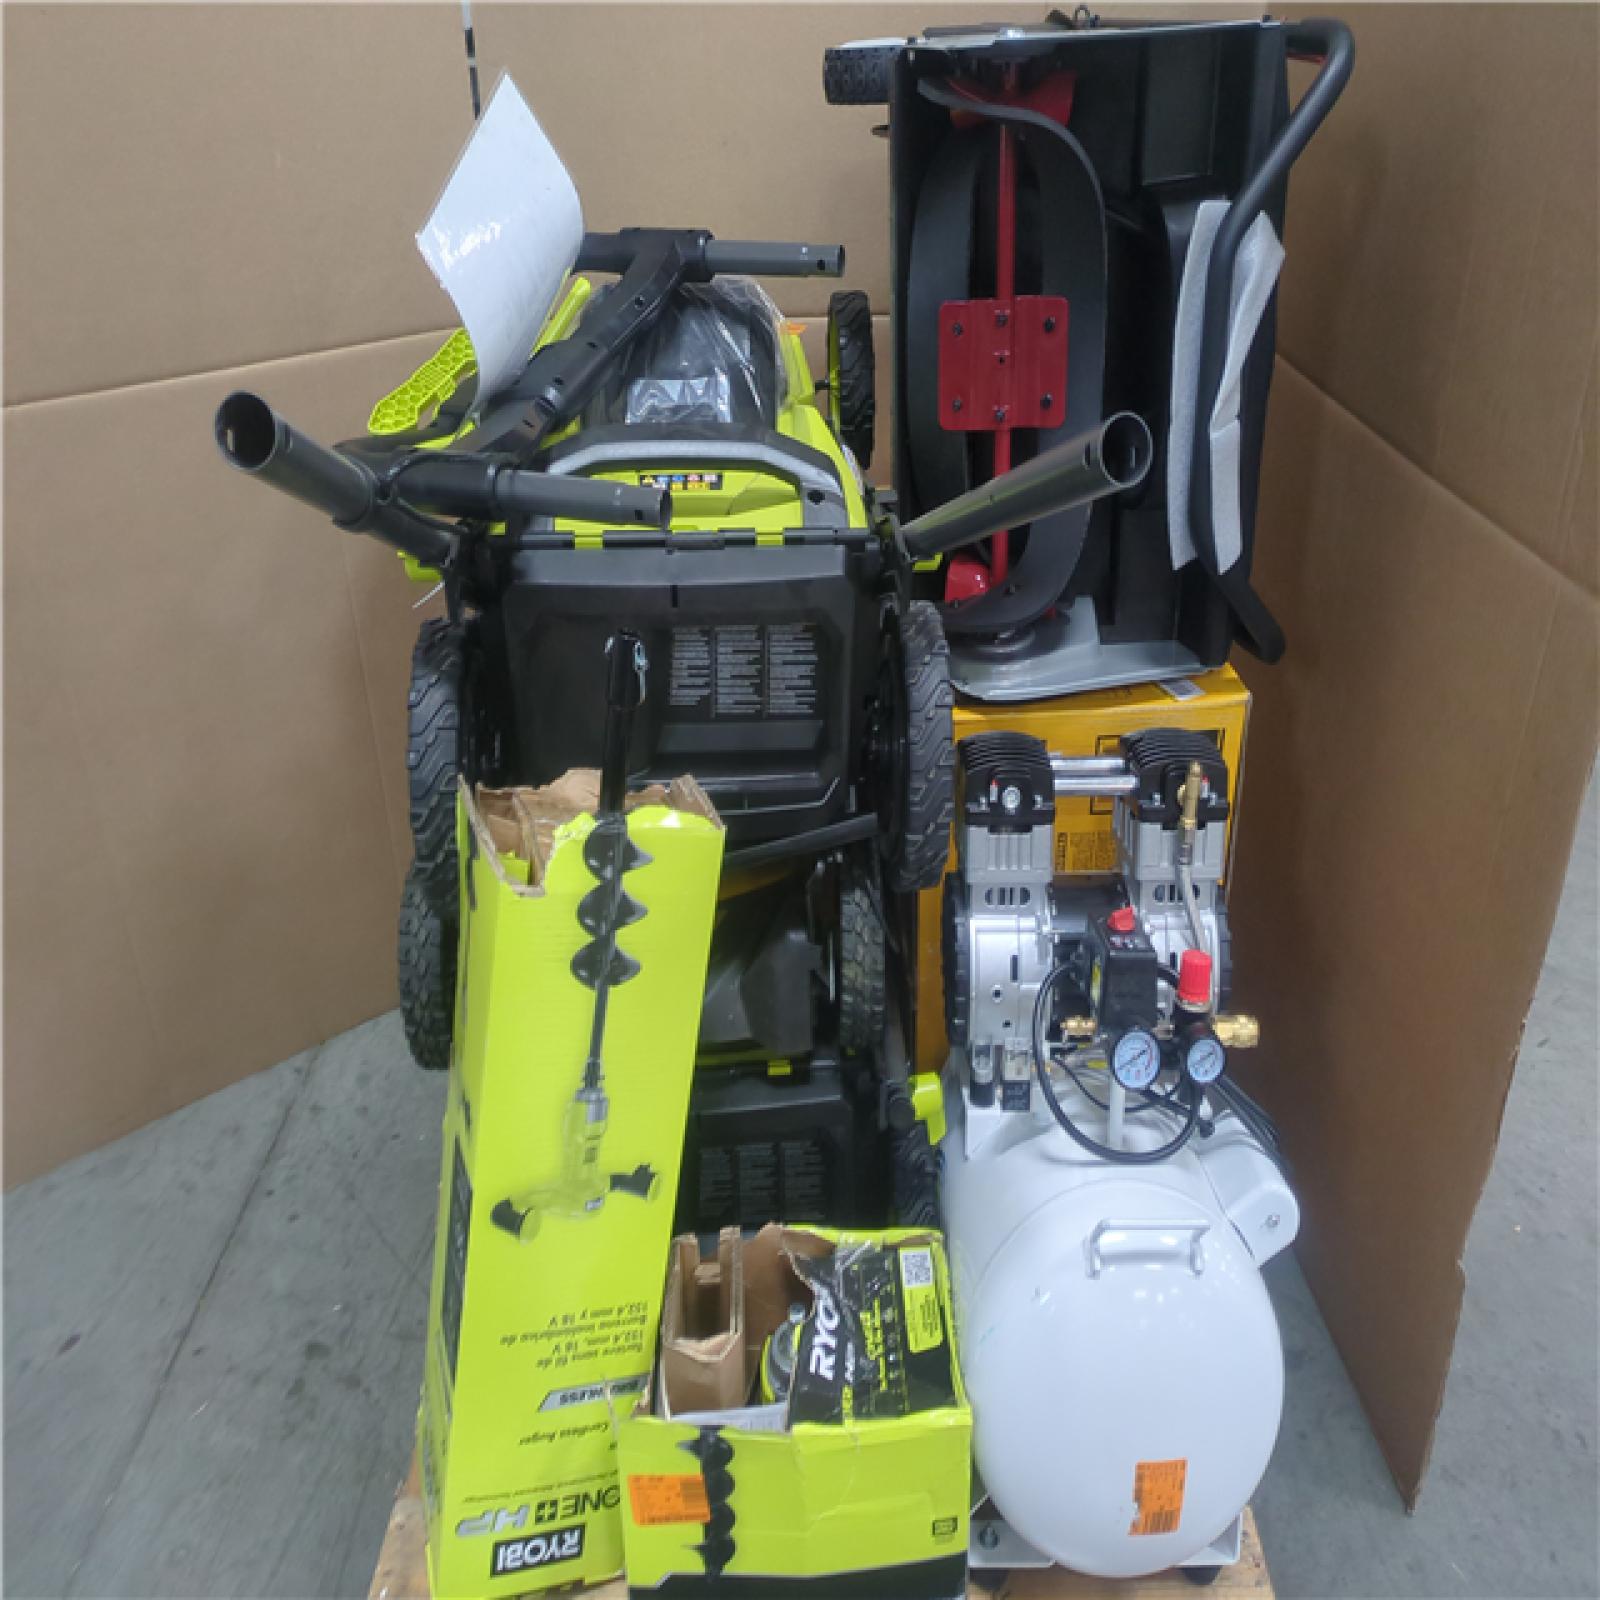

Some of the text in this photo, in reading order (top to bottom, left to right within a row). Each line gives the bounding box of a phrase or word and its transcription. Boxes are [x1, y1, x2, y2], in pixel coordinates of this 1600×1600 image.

[519, 1422, 609, 1446] Cordless Auger
[497, 1529, 581, 1571] RYOBI
